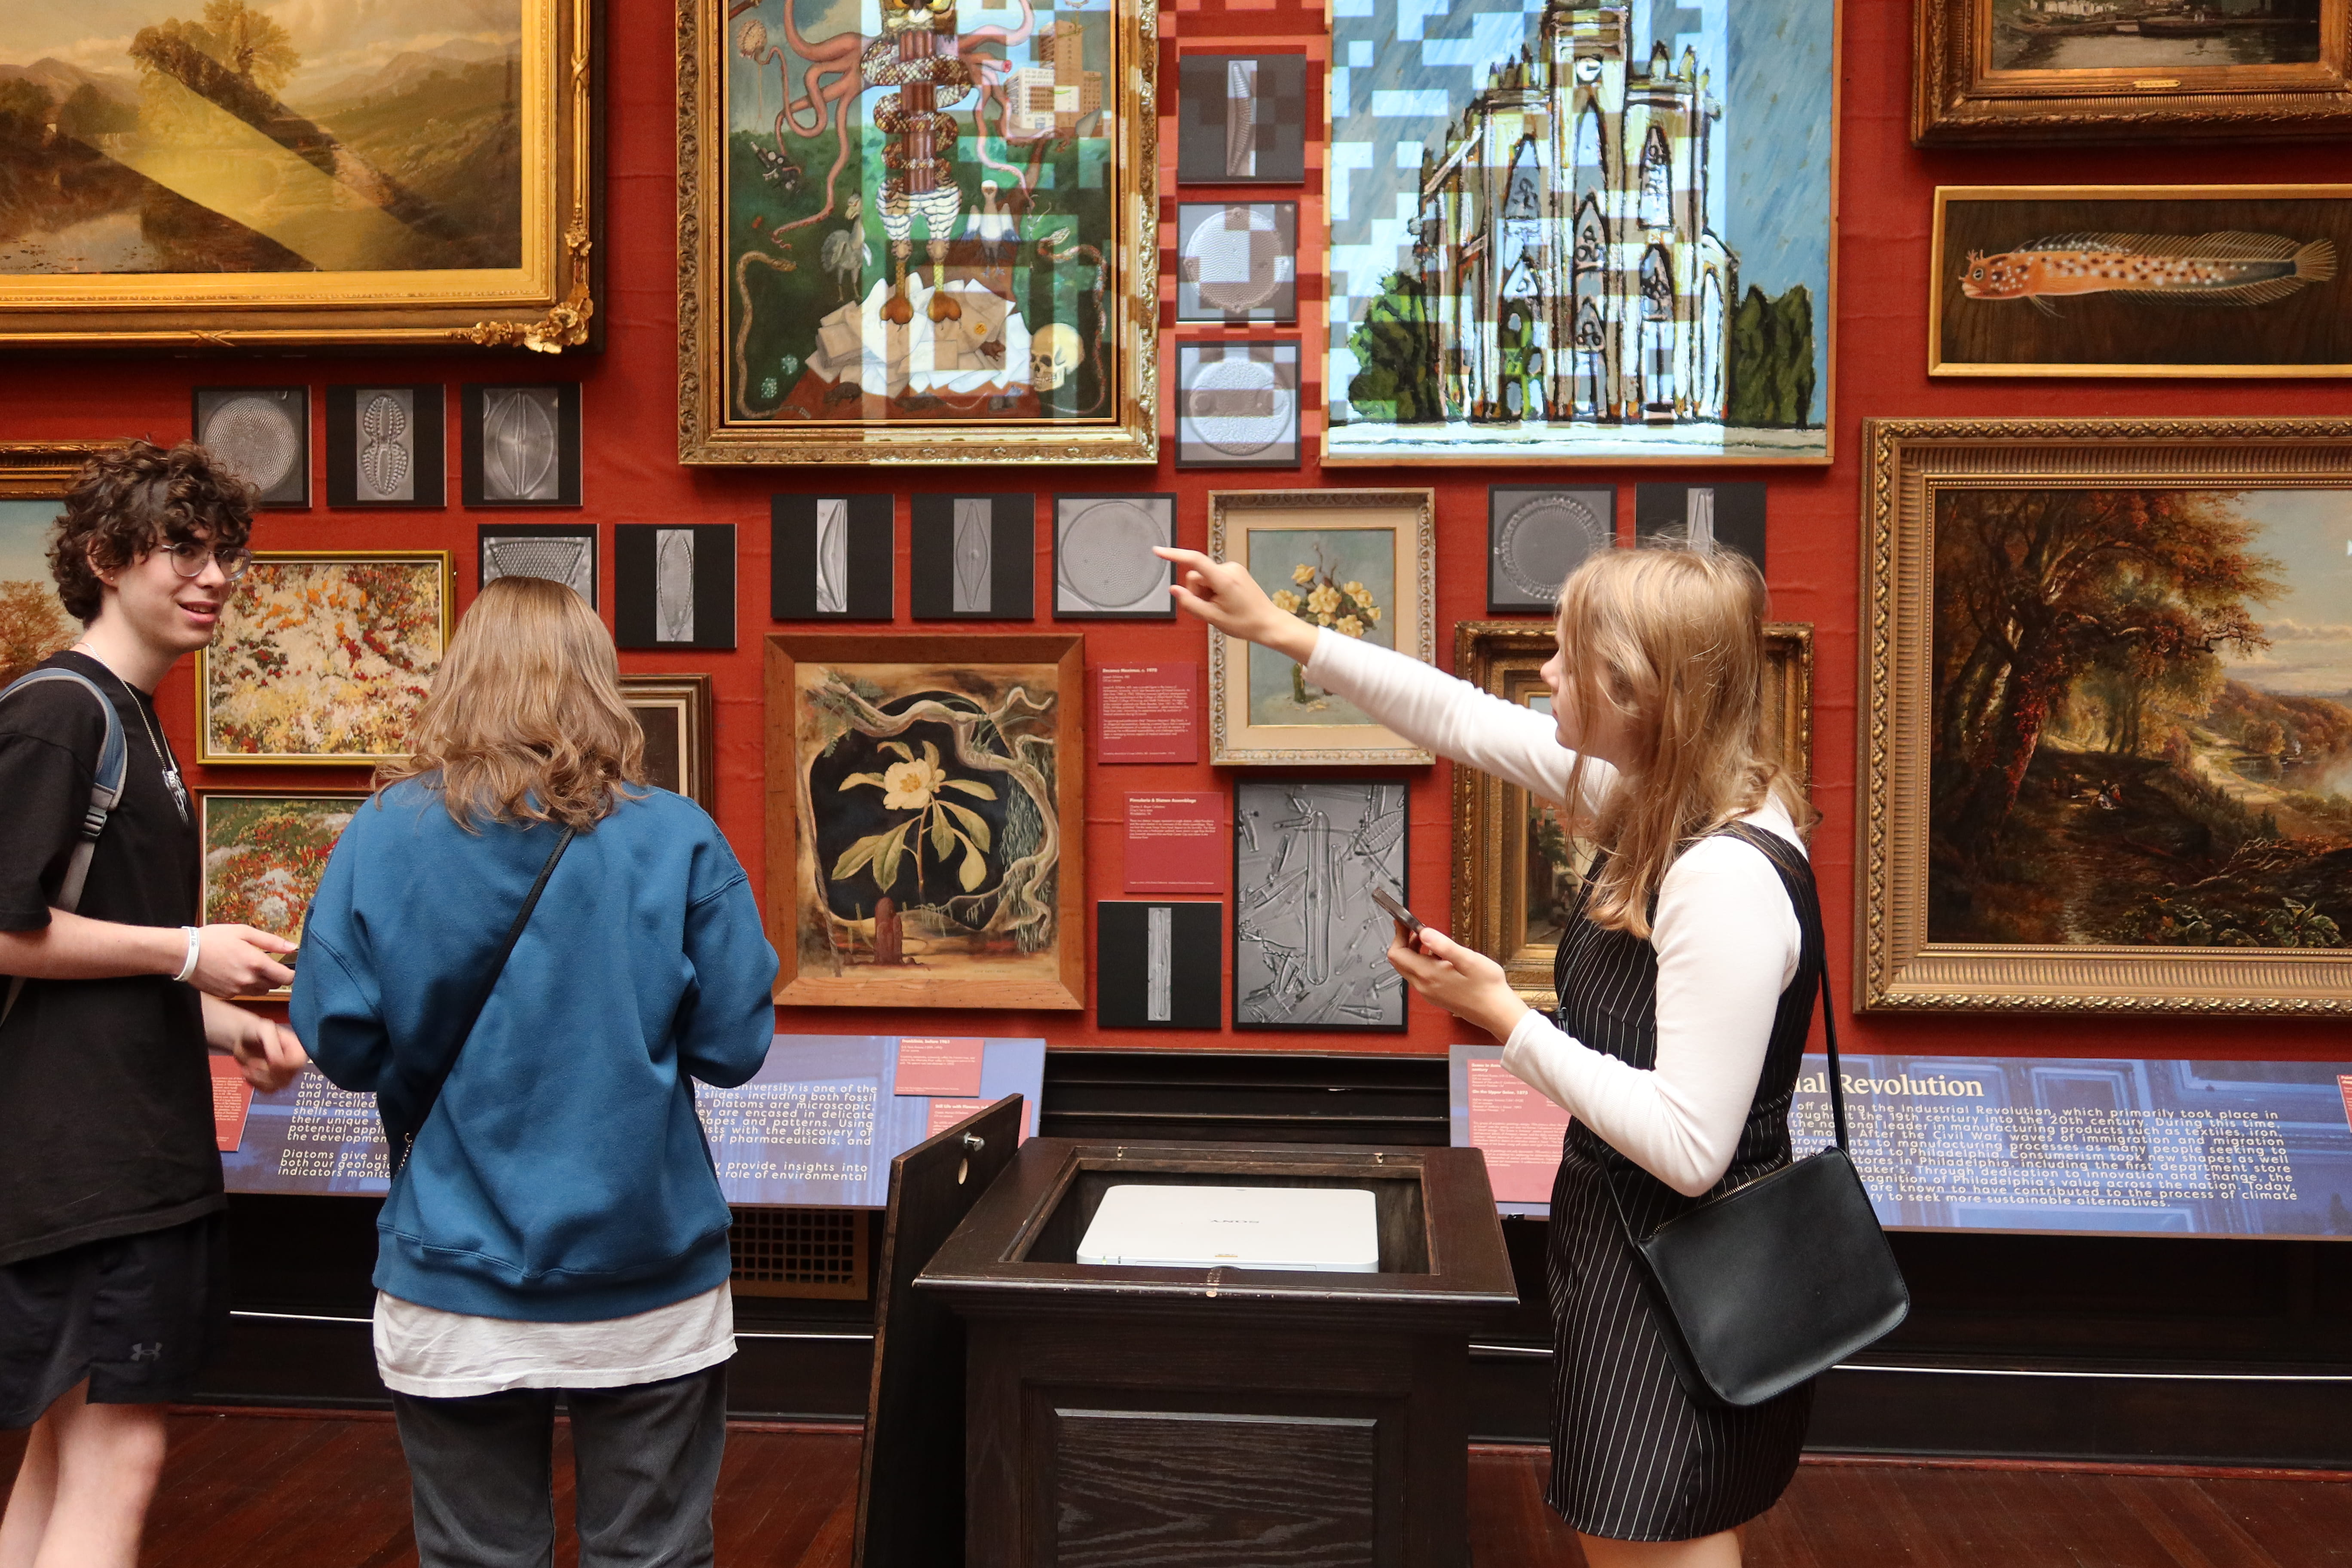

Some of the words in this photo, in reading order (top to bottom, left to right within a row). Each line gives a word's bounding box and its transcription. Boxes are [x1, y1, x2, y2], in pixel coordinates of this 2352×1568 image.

[300, 1081, 322, 1089] two
[748, 1091, 806, 1103] including
[811, 1092, 839, 1101] both
[844, 1092, 876, 1102] fossil
[303, 1072, 324, 1081] The
[799, 1083, 808, 1092] is
[840, 1084, 852, 1093] of
[857, 1084, 877, 1093] the
[1841, 1073, 1984, 1097] Revolution
[295, 1097, 376, 1109] single-celled
[745, 1109, 797, 1118] encased
[804, 1109, 815, 1118] in
[822, 1109, 874, 1119] delicate
[297, 1089, 322, 1098] and
[713, 1099, 763, 1108] Diatoms
[293, 1106, 328, 1115] shells
[334, 1107, 368, 1116] made
[702, 1116, 735, 1127] hapes
[742, 1117, 766, 1126] and
[839, 1118, 873, 1130] Using
[1797, 1102, 1815, 1111] off
[1871, 1103, 1894, 1112] the
[1901, 1103, 1969, 1114] Industrial
[2061, 1107, 2103, 1116] which
[2110, 1108, 2174, 1120] primarily
[2180, 1109, 2213, 1118] took
[2219, 1110, 2258, 1121] place
[2265, 1111, 2278, 1119] in
[1860, 1112, 1883, 1121] the
[1890, 1112, 1919, 1121] 19th
[1925, 1114, 1978, 1125] century
[1985, 1114, 2013, 1123] into
[2019, 1115, 2043, 1124] the
[2049, 1115, 2083, 1124] 20th
[2155, 1117, 2202, 1129] During
[2209, 1118, 2236, 1127] this
[288, 1124, 346, 1134] potential
[711, 1134, 723, 1142] of
[847, 1136, 871, 1145] and
[291, 1114, 321, 1124] their
[327, 1116, 369, 1127] unique
[732, 1125, 758, 1134] with
[766, 1126, 786, 1135] the
[793, 1126, 853, 1139] discovery
[860, 1127, 872, 1136] of
[1792, 1119, 1814, 1128] the
[1883, 1121, 1928, 1130] leader
[1933, 1122, 1945, 1130] in
[1950, 1123, 2055, 1135] manufacturing
[2060, 1124, 2123, 1136] products
[2128, 1126, 2159, 1135] such
[287, 1131, 307, 1140] the
[312, 1132, 386, 1145] developmen
[1859, 1129, 1894, 1139] After
[1902, 1130, 1925, 1139] the
[1932, 1130, 1963, 1140] Civil
[2060, 1133, 2074, 1142] of
[2082, 1133, 2170, 1145] immigration
[2178, 1136, 2205, 1144] and
[2213, 1136, 2284, 1148] migration
[1876, 1139, 1890, 1147] to
[1897, 1139, 2002, 1152] manufacturing
[2009, 1143, 2079, 1152] processes
[2108, 1145, 2146, 1155] many
[2153, 1144, 2202, 1155] people
[2209, 1145, 2264, 1157] seeking
[2271, 1146, 2286, 1155] to
[1890, 1148, 1903, 1156] to
[2009, 1150, 2104, 1160] Consumerism
[2110, 1152, 2143, 1161] took
[2182, 1153, 2232, 1165] shapes
[2259, 1155, 2289, 1164] well
[280, 1157, 309, 1167] both
[725, 1170, 750, 1179] role
[754, 1170, 767, 1179] of
[771, 1171, 867, 1180] environmental
[282, 1148, 334, 1159] Diatoms
[341, 1151, 368, 1162] give
[727, 1161, 777, 1172] provide
[784, 1162, 834, 1173] insights
[842, 1163, 868, 1172] into
[1853, 1156, 1893, 1165] stores
[1899, 1157, 1912, 1165] in
[2021, 1159, 2088, 1171] including
[2094, 1160, 2118, 1169] the
[2125, 1161, 2154, 1170] first
[2160, 1161, 2248, 1173] department
[2253, 1164, 2291, 1173] store
[278, 1166, 342, 1177] indicators
[1916, 1166, 1974, 1178] Through
[1981, 1167, 2058, 1177] dedication
[2086, 1169, 2163, 1179] innovation
[2170, 1171, 2197, 1180] and
[2268, 1173, 2293, 1182] the
[1861, 1175, 1926, 1185] cognition
[1932, 1175, 1945, 1184] of
[1953, 1176, 2055, 1188] Philadelphia's
[2061, 1178, 2100, 1187] value
[2158, 1179, 2182, 1188] the
[1888, 1193, 1903, 1201] to
[1908, 1193, 1941, 1202] seek
[1987, 1195, 2071, 1204] sustainable
[1899, 1184, 1944, 1193] known
[1951, 1185, 1966, 1194] to
[1973, 1185, 2007, 1194] have
[2014, 1187, 2099, 1196] contributed
[2106, 1188, 2121, 1197] to
[2128, 1188, 2153, 1197] the
[2159, 1191, 2214, 1200] process
[2220, 1190, 2234, 1199] of
[2241, 1190, 2297, 1200] climate
